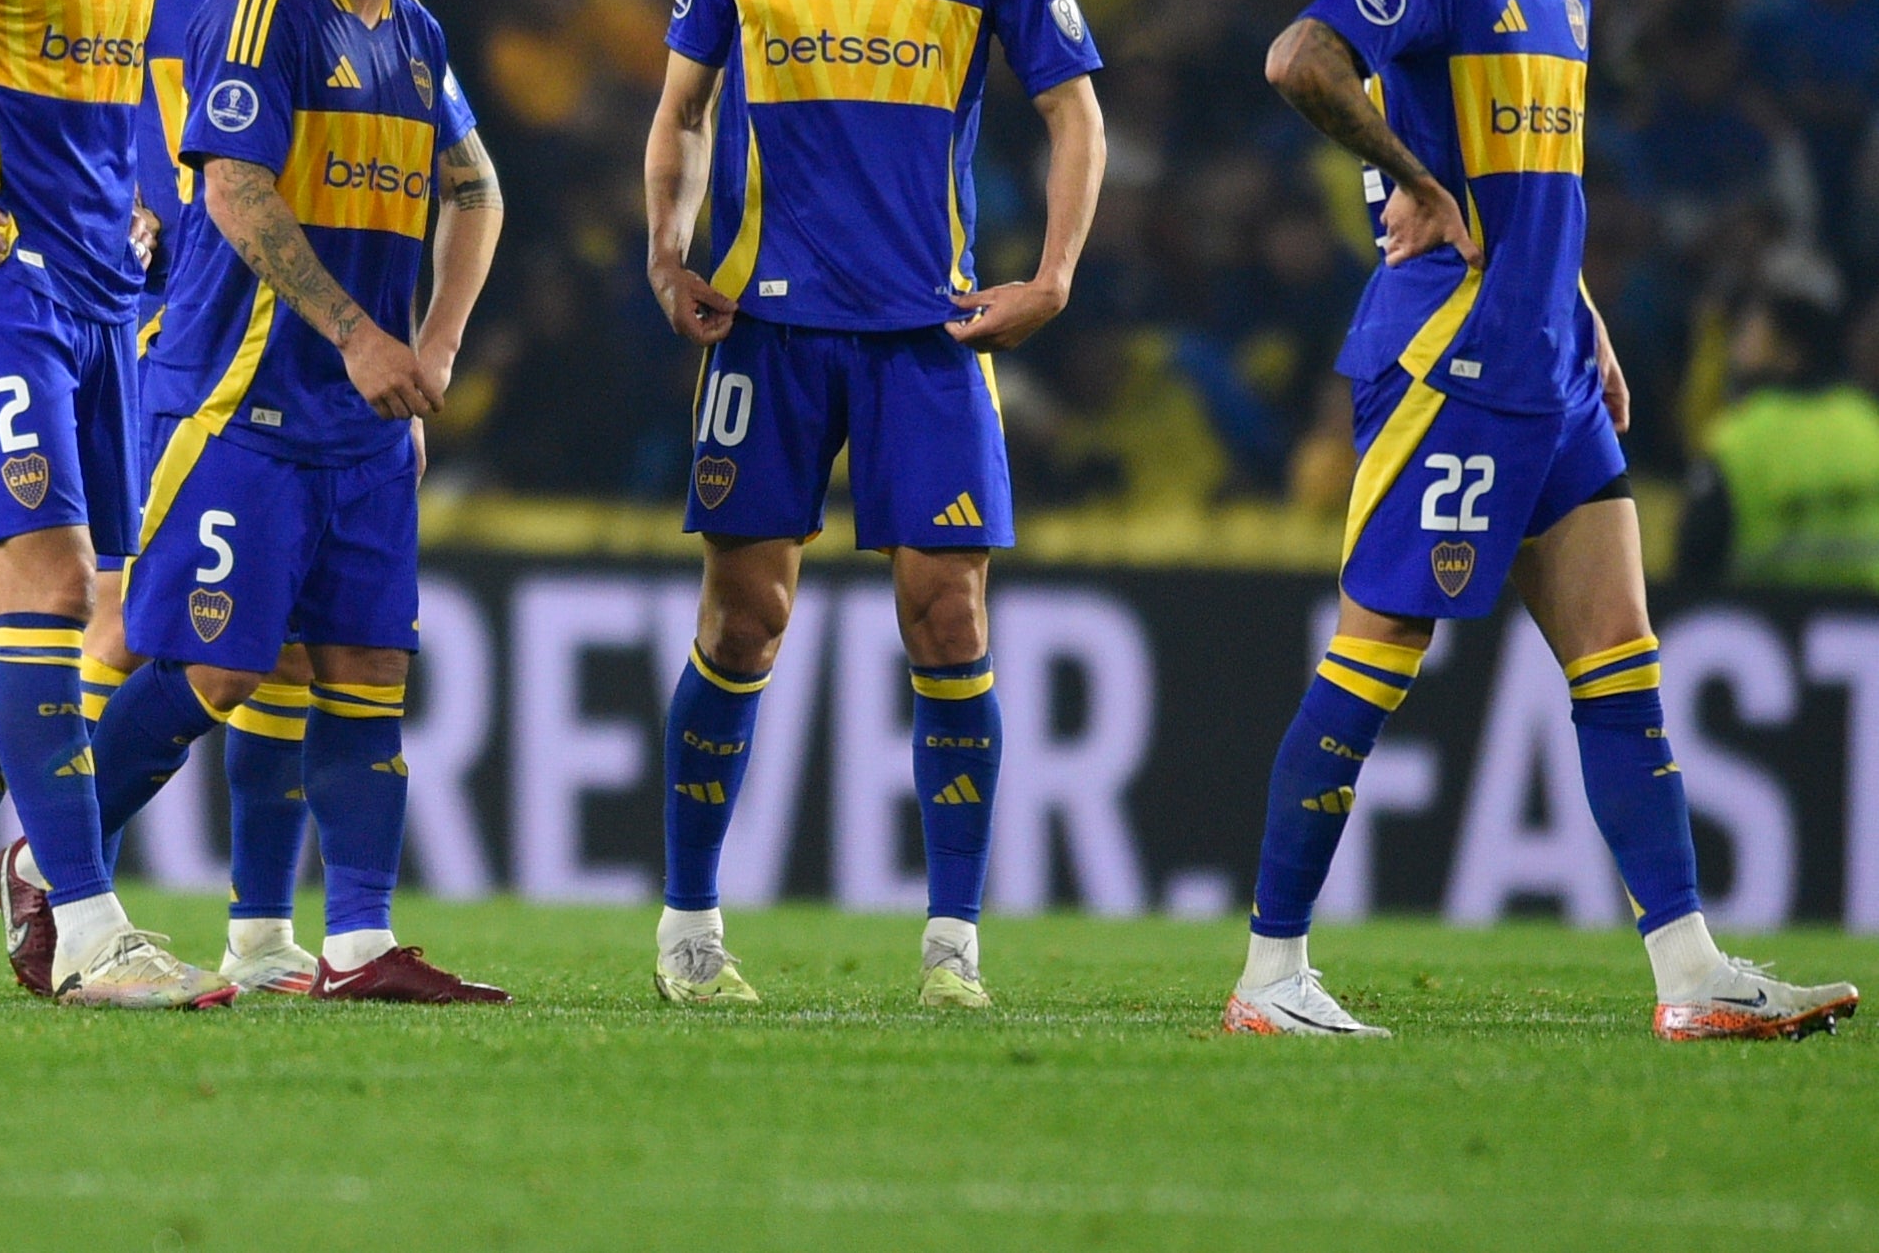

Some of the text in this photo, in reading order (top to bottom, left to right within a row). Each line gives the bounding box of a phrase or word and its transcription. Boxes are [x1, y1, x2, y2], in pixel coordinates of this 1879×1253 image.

[765, 28, 942, 71] betsson
[698, 370, 753, 447] 10
[9, 470, 45, 488] CABJ
[698, 474, 730, 487] CABJ
[1421, 453, 1495, 532] 22
[195, 509, 237, 584] 5
[1436, 560, 1469, 572] CABJ
[193, 605, 227, 621] CABJ
[683, 731, 746, 757] CABJ
[925, 735, 990, 749] CABJ
